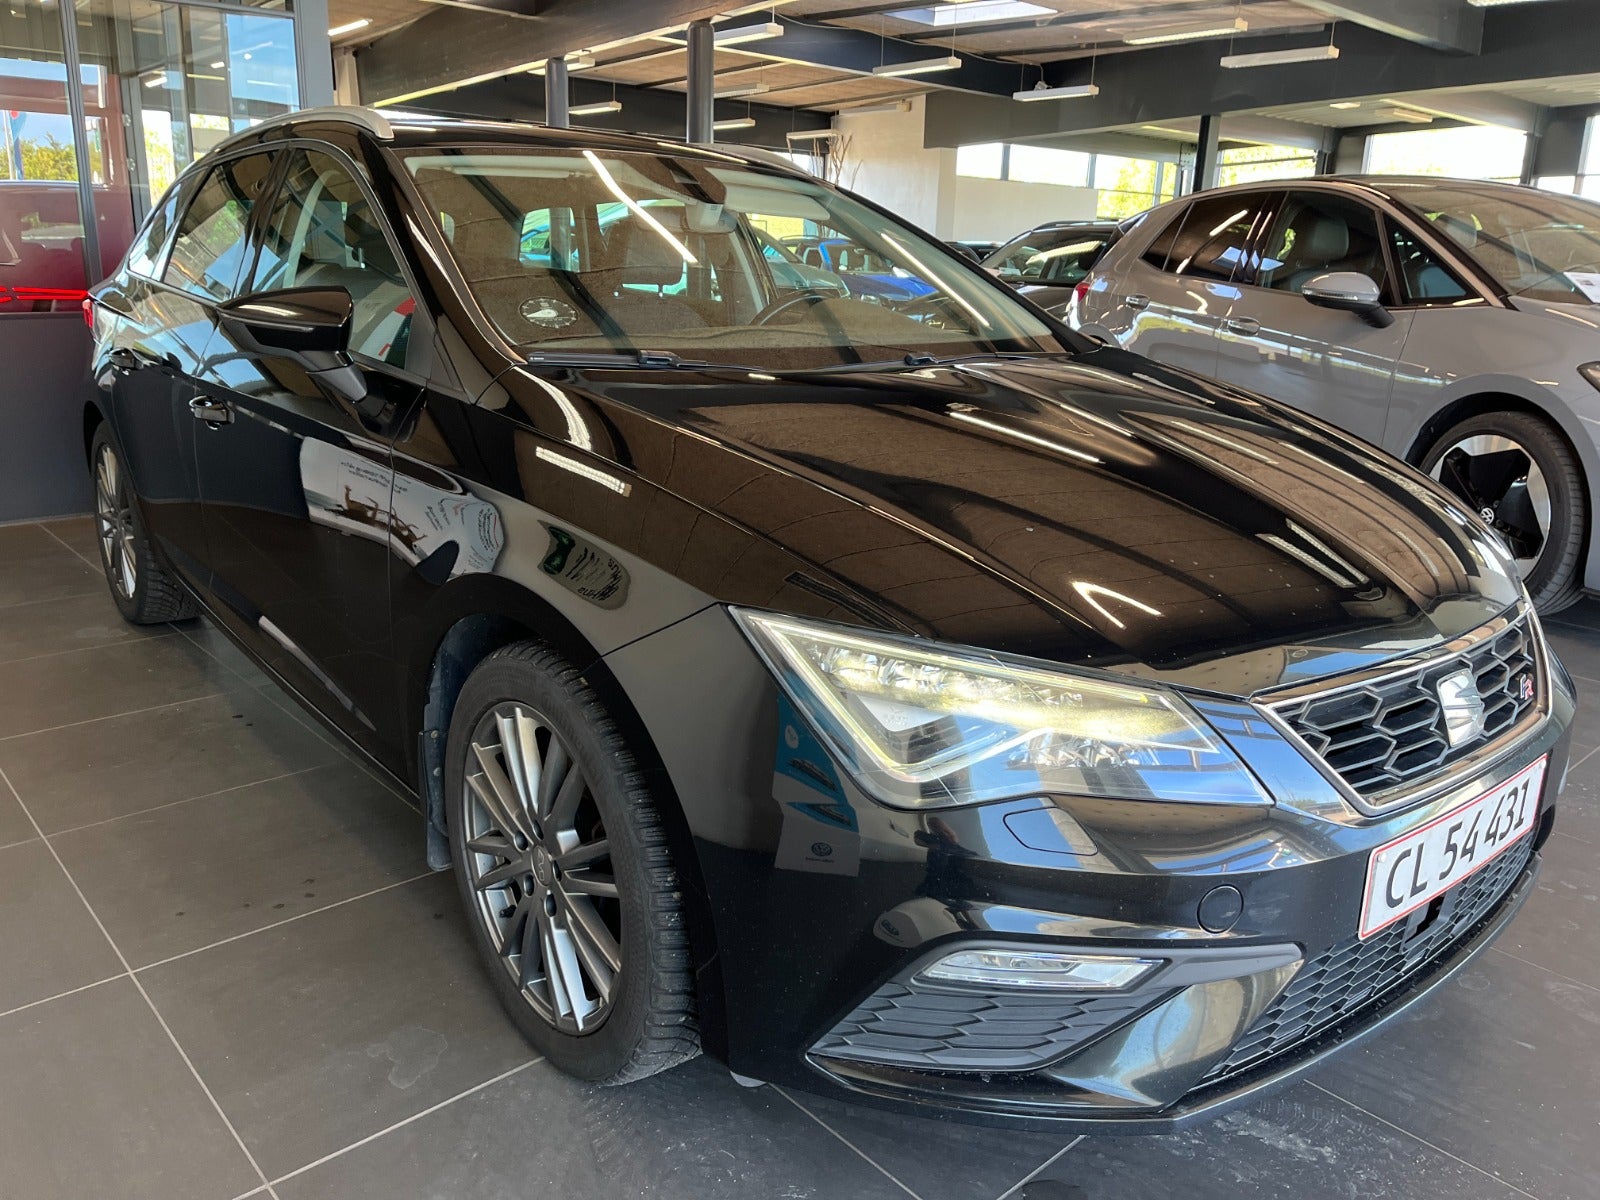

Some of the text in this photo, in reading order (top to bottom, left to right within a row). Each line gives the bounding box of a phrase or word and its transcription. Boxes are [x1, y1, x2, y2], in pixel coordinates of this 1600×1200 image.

[1385, 776, 1530, 909] CL 54 431
